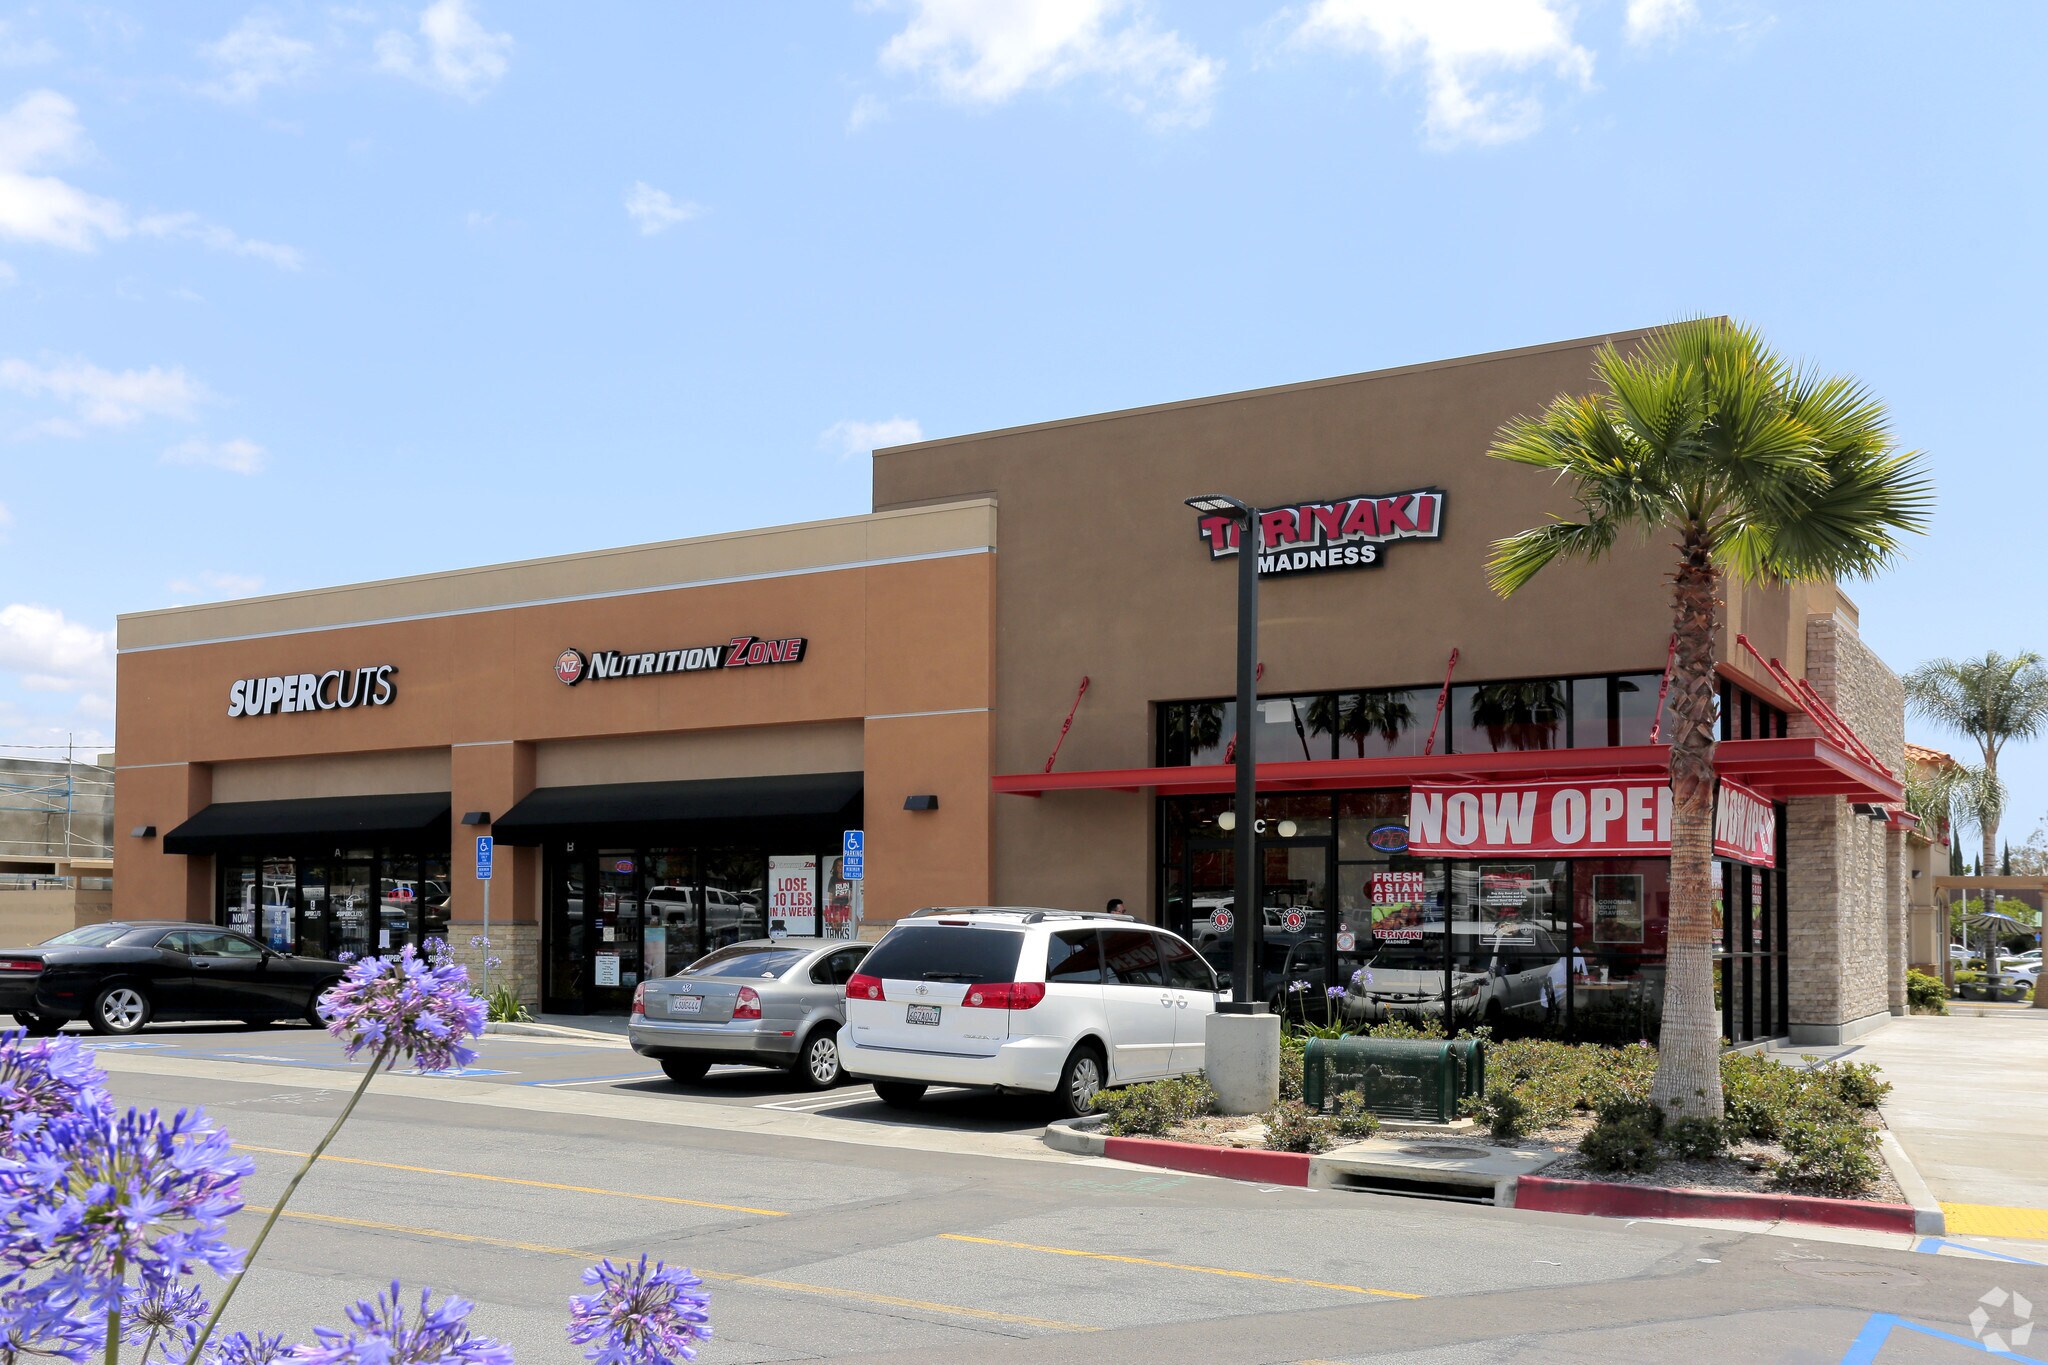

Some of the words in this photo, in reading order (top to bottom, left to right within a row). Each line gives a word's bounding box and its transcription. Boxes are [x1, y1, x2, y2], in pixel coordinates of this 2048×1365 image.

[1200, 494, 1440, 551] TRIYAKI
[1257, 545, 1376, 574] MADNESS
[588, 646, 722, 678] NUTRITION
[725, 637, 802, 667] ZONE
[560, 660, 577, 673] NZ
[228, 664, 393, 717] SUPERCUTS
[1409, 791, 1538, 845] NOW
[1254, 819, 1266, 833] C
[335, 848, 341, 857] A
[1373, 872, 1423, 882] FRESH
[778, 878, 807, 891] LOSE
[1373, 883, 1423, 893] ASIAN
[774, 893, 786, 906] 10
[791, 892, 812, 906] LBS
[1373, 893, 1423, 902] GRILL
[232, 914, 248, 923] NOW
[770, 907, 778, 917] IN
[781, 907, 786, 917] A
[229, 924, 252, 934] HIRING
[1373, 930, 1423, 940] TERIYAKI
